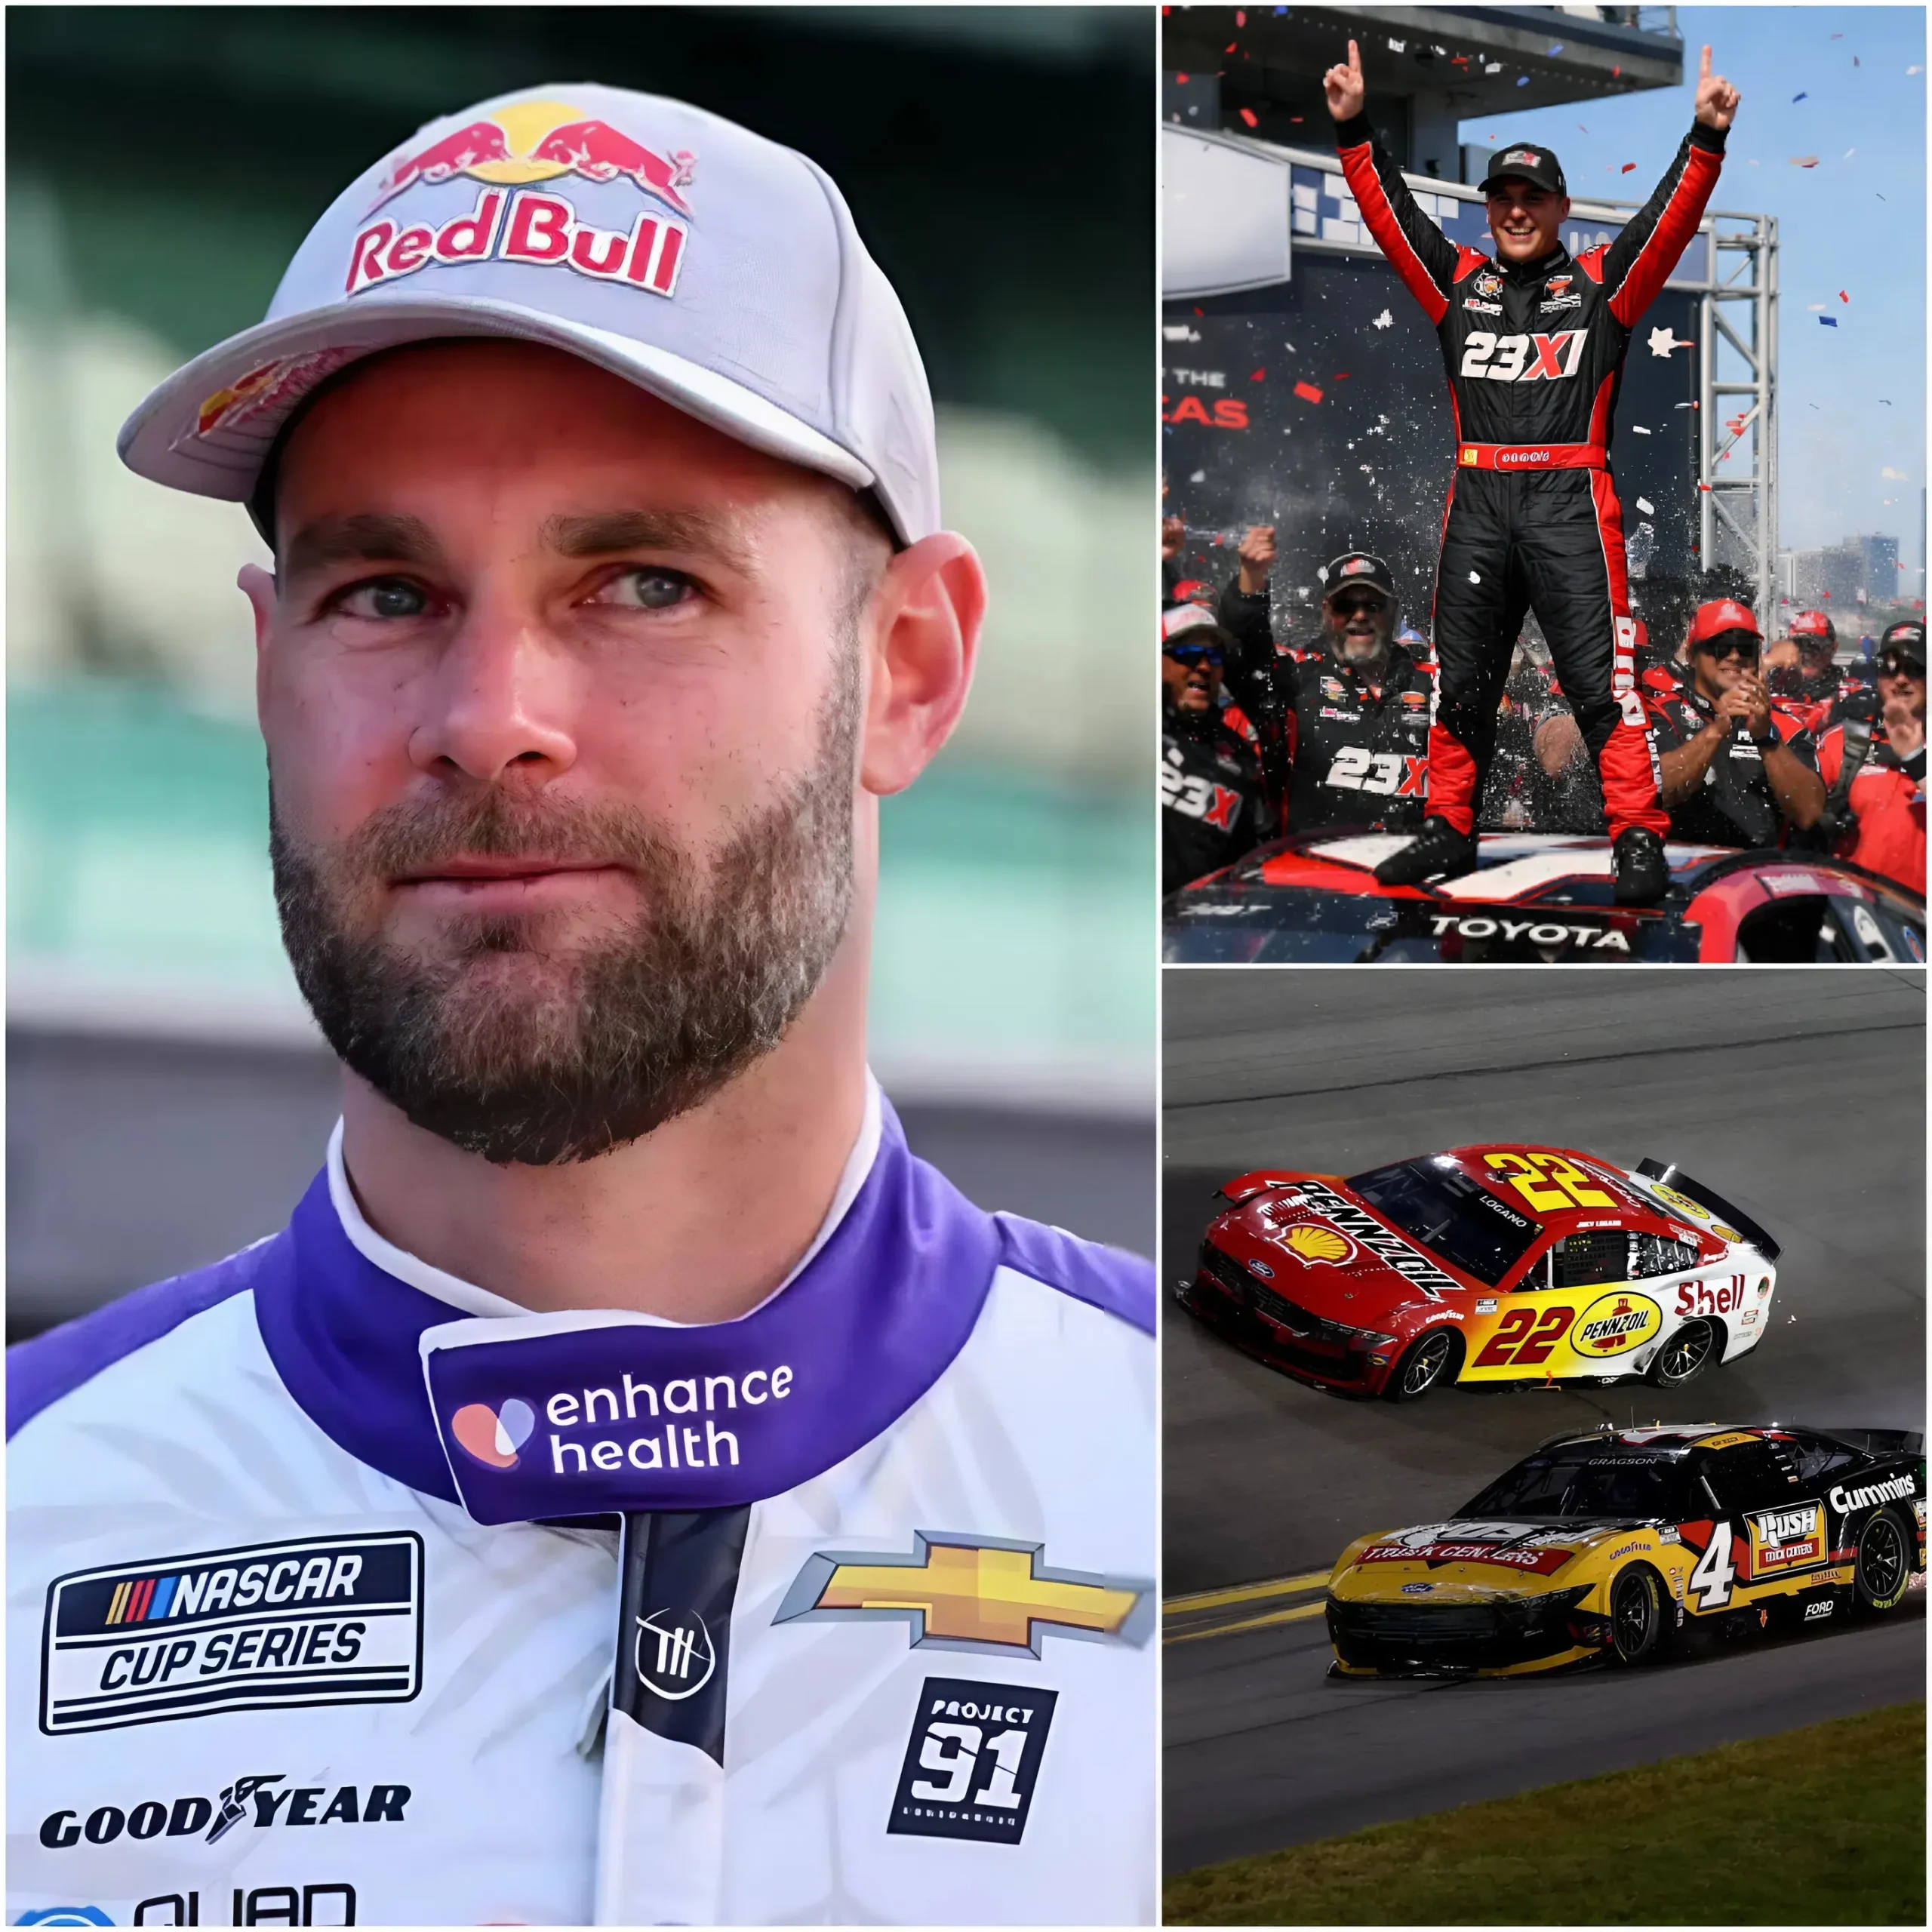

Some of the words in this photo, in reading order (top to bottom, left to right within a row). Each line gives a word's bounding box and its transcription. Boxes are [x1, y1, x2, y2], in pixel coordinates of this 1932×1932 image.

[345, 191, 502, 294] Red
[505, 192, 686, 295] Bull
[1172, 368, 1226, 389] THE
[1429, 914, 1631, 952] TOYOTA
[1483, 1152, 1619, 1213] 22
[1478, 1195, 1527, 1228] LOGANO
[1674, 1273, 1745, 1316] Shell
[1471, 1306, 1576, 1367] 22
[1580, 1309, 1650, 1342] PENNZOIL
[546, 1365, 793, 1426] enhance
[550, 1421, 740, 1474] health
[1588, 1457, 1657, 1466] GRAGSON
[1829, 1472, 1915, 1514] Cummins
[168, 1553, 363, 1618] NASCAR
[1687, 1519, 1737, 1612] 4
[1805, 1600, 1834, 1617] FORD
[99, 1640, 197, 1692] CUP
[199, 1622, 366, 1675] SERIES
[910, 1721, 1028, 1809] 91
